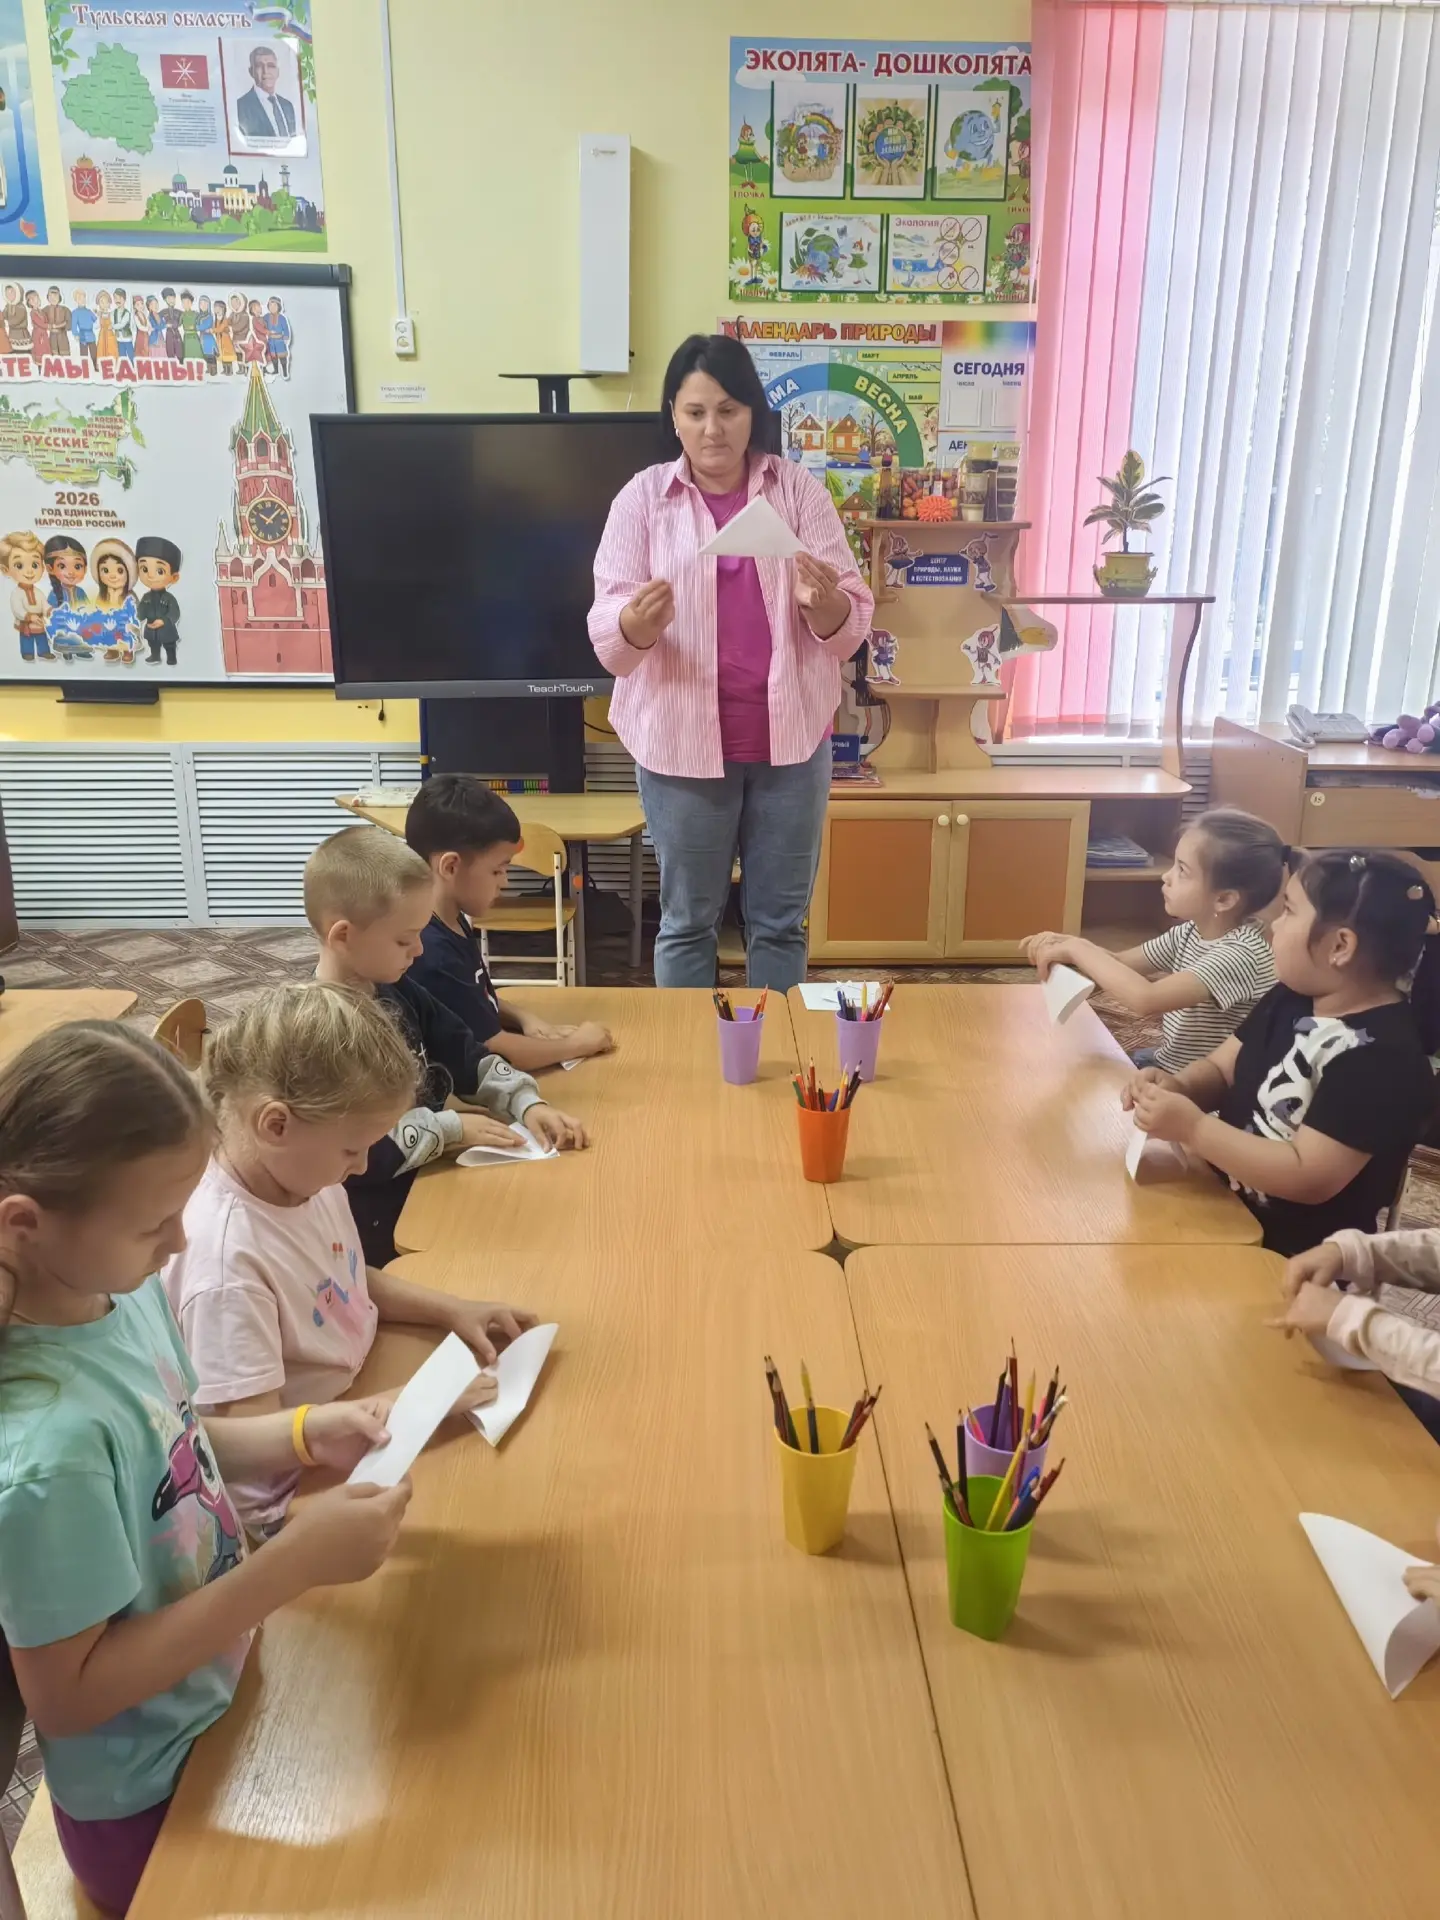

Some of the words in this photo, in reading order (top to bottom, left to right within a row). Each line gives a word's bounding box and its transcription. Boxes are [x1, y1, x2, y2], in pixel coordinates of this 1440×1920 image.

[72, 5, 168, 30] Тульская
[173, 12, 252, 28] область
[746, 49, 867, 73] ЭКОЛЯТА-
[874, 53, 1031, 77] ДОШКОЛЯТА
[895, 217, 940, 227] Экология
[723, 321, 838, 342] КАЛЕНДАРЬ
[840, 322, 937, 344] ПРИРОДЫ
[0, 357, 32, 378] ТЕ
[44, 357, 91, 379] МЫ
[100, 359, 205, 382] ЕДИНЫ!
[953, 361, 1025, 378] СЕГОДНЯ
[767, 378, 801, 408] МА
[908, 393, 923, 401] МАЙ
[854, 375, 908, 434] ВЕСНА
[23, 434, 90, 449] РУССКИЕ
[55, 491, 100, 506] 2026
[41, 508, 62, 517] ГОД
[64, 508, 118, 518] ЕДИНСТВА
[35, 518, 83, 527] НАРОДОВ
[85, 519, 126, 528] РОССИИ
[527, 684, 594, 693] TeachTouch
